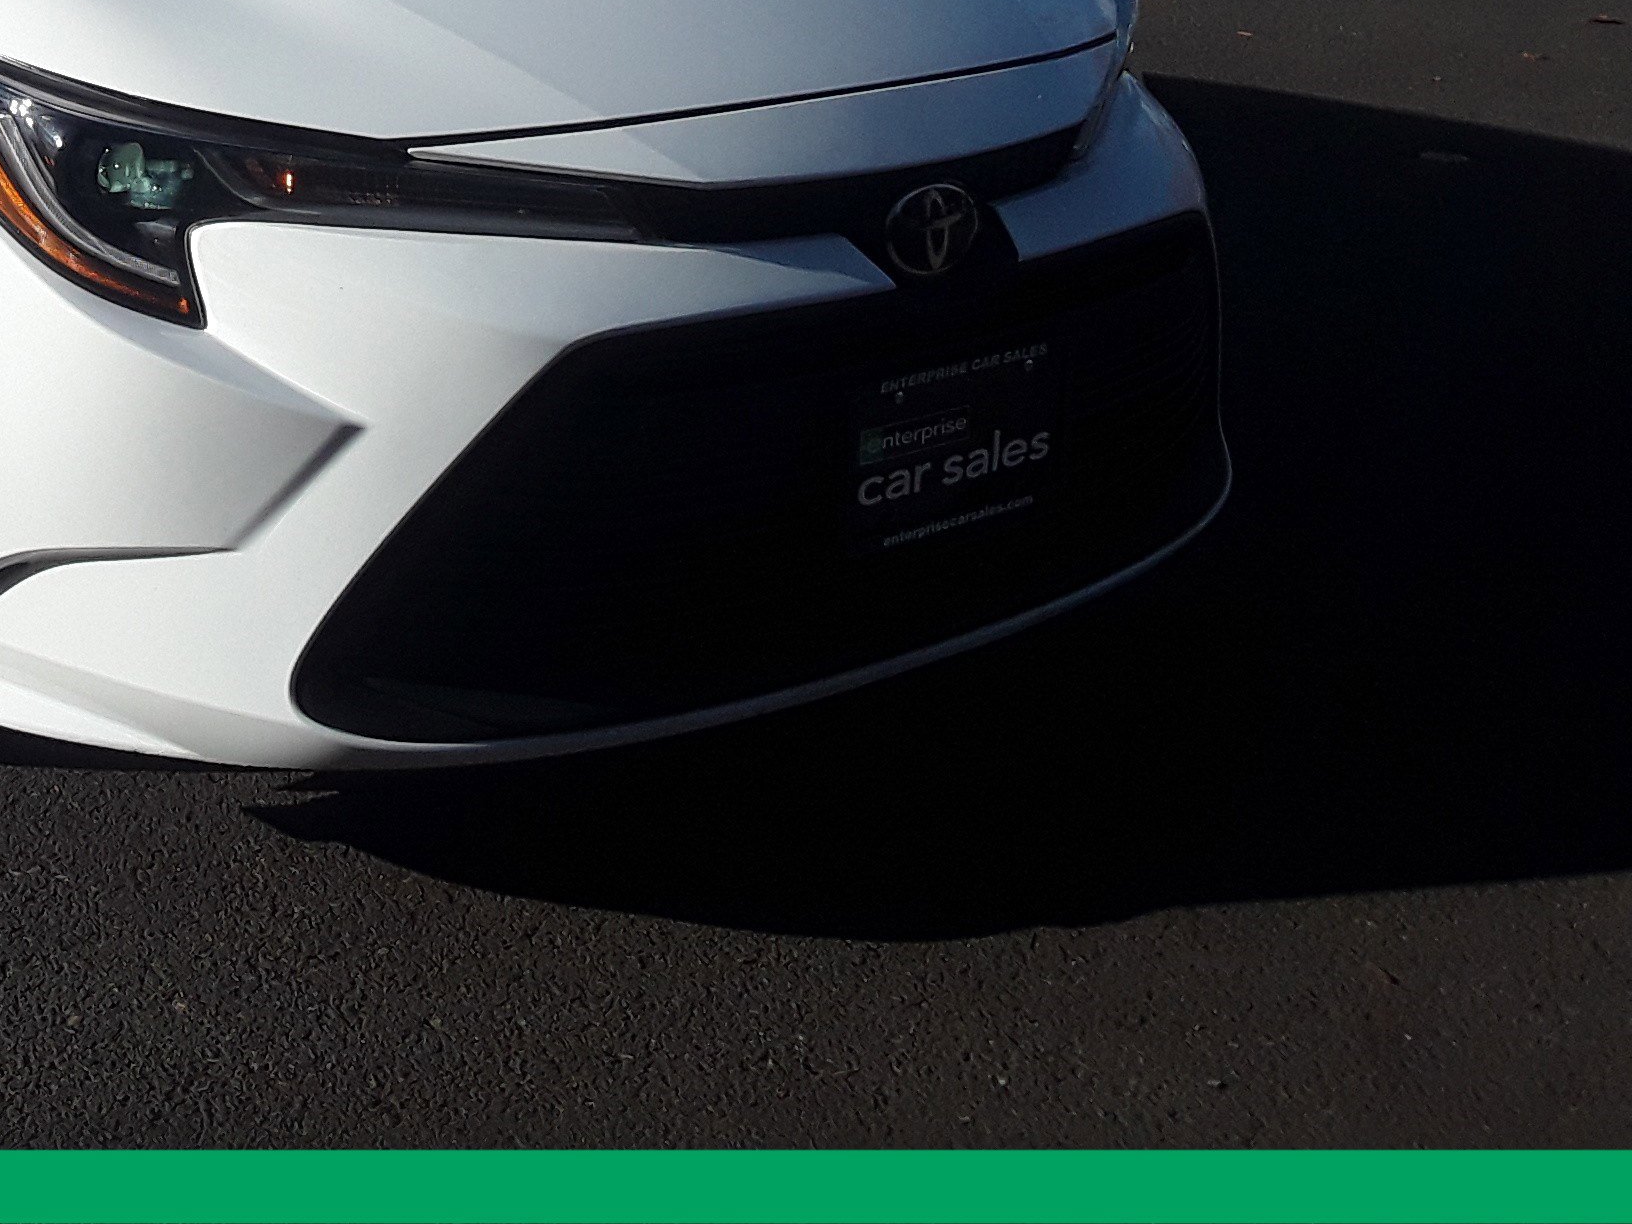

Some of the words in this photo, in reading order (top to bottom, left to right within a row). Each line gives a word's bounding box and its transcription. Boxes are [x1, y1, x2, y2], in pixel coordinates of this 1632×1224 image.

[880, 364, 967, 394] ENTERPRISE
[971, 354, 1000, 371] CAR
[1003, 342, 1048, 364] SALES
[858, 462, 931, 506] car
[942, 430, 1050, 486] sales
[883, 495, 1034, 546] enterprisecarsales.com
